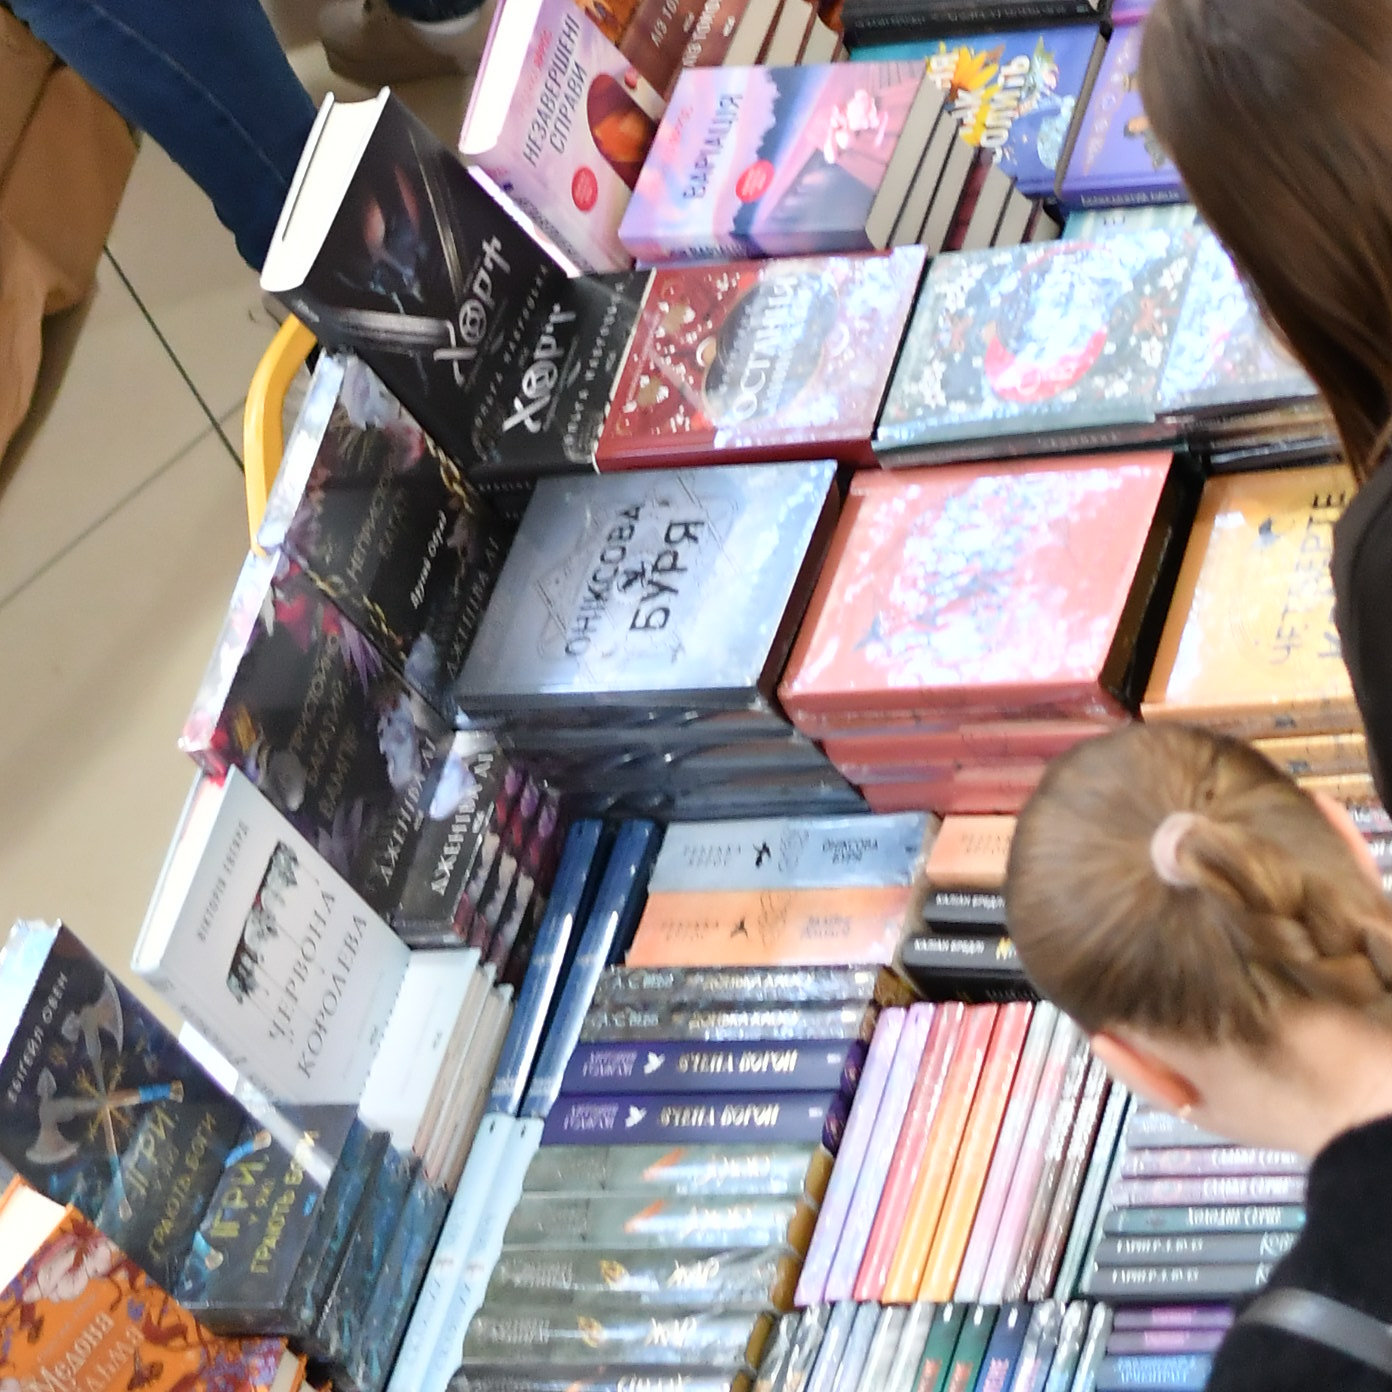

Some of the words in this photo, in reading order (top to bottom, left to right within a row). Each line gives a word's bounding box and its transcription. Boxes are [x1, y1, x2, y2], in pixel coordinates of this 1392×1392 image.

[522, 11, 582, 168] НЕЗАВЕРШЕНІ
[550, 60, 590, 155] СПРАВИ
[683, 92, 743, 201] ВАРІАЦІЯ
[566, 503, 644, 658] ОНІКСОВА
[629, 517, 706, 632] БУРЯ
[269, 886, 337, 1045] ЧЕРВОНА
[296, 914, 370, 1080] КОРОЛЕВА
[210, 1154, 268, 1241] ІГРИ
[247, 1183, 292, 1274] ГРАЮТЬ
